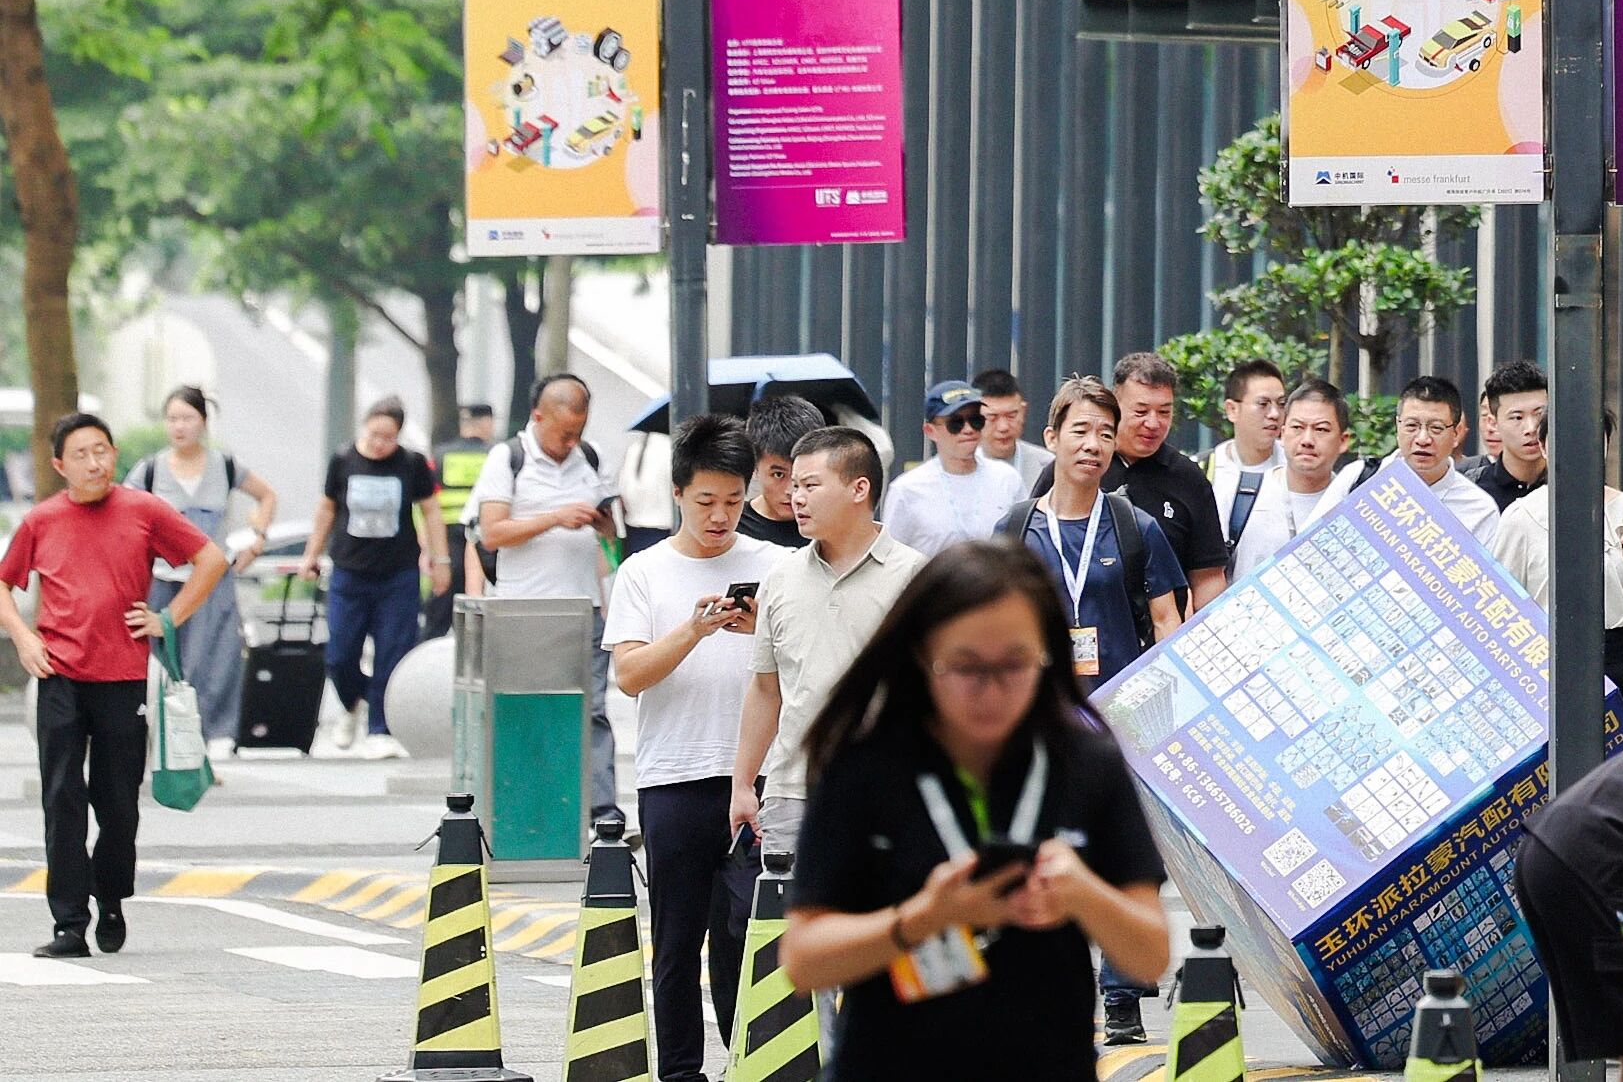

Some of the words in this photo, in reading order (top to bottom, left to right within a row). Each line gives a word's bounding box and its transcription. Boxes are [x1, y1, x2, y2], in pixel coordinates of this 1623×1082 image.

[1335, 171, 1364, 180] 中机国际
[1404, 176, 1431, 184] messe
[1433, 175, 1471, 184] frankfurt
[1353, 499, 1399, 553] YUHUAN
[1396, 543, 1463, 613] PARAMOUNT
[1456, 612, 1489, 643] AUTO
[1486, 641, 1522, 678] PARTS
[1370, 476, 1549, 681] 玉环派拉蒙汽配有限
[1326, 923, 1388, 972] YUHUAN
[1389, 851, 1478, 926] PARAMOUNT
[1481, 818, 1520, 853] AUTO
[1522, 794, 1550, 819] PAR
